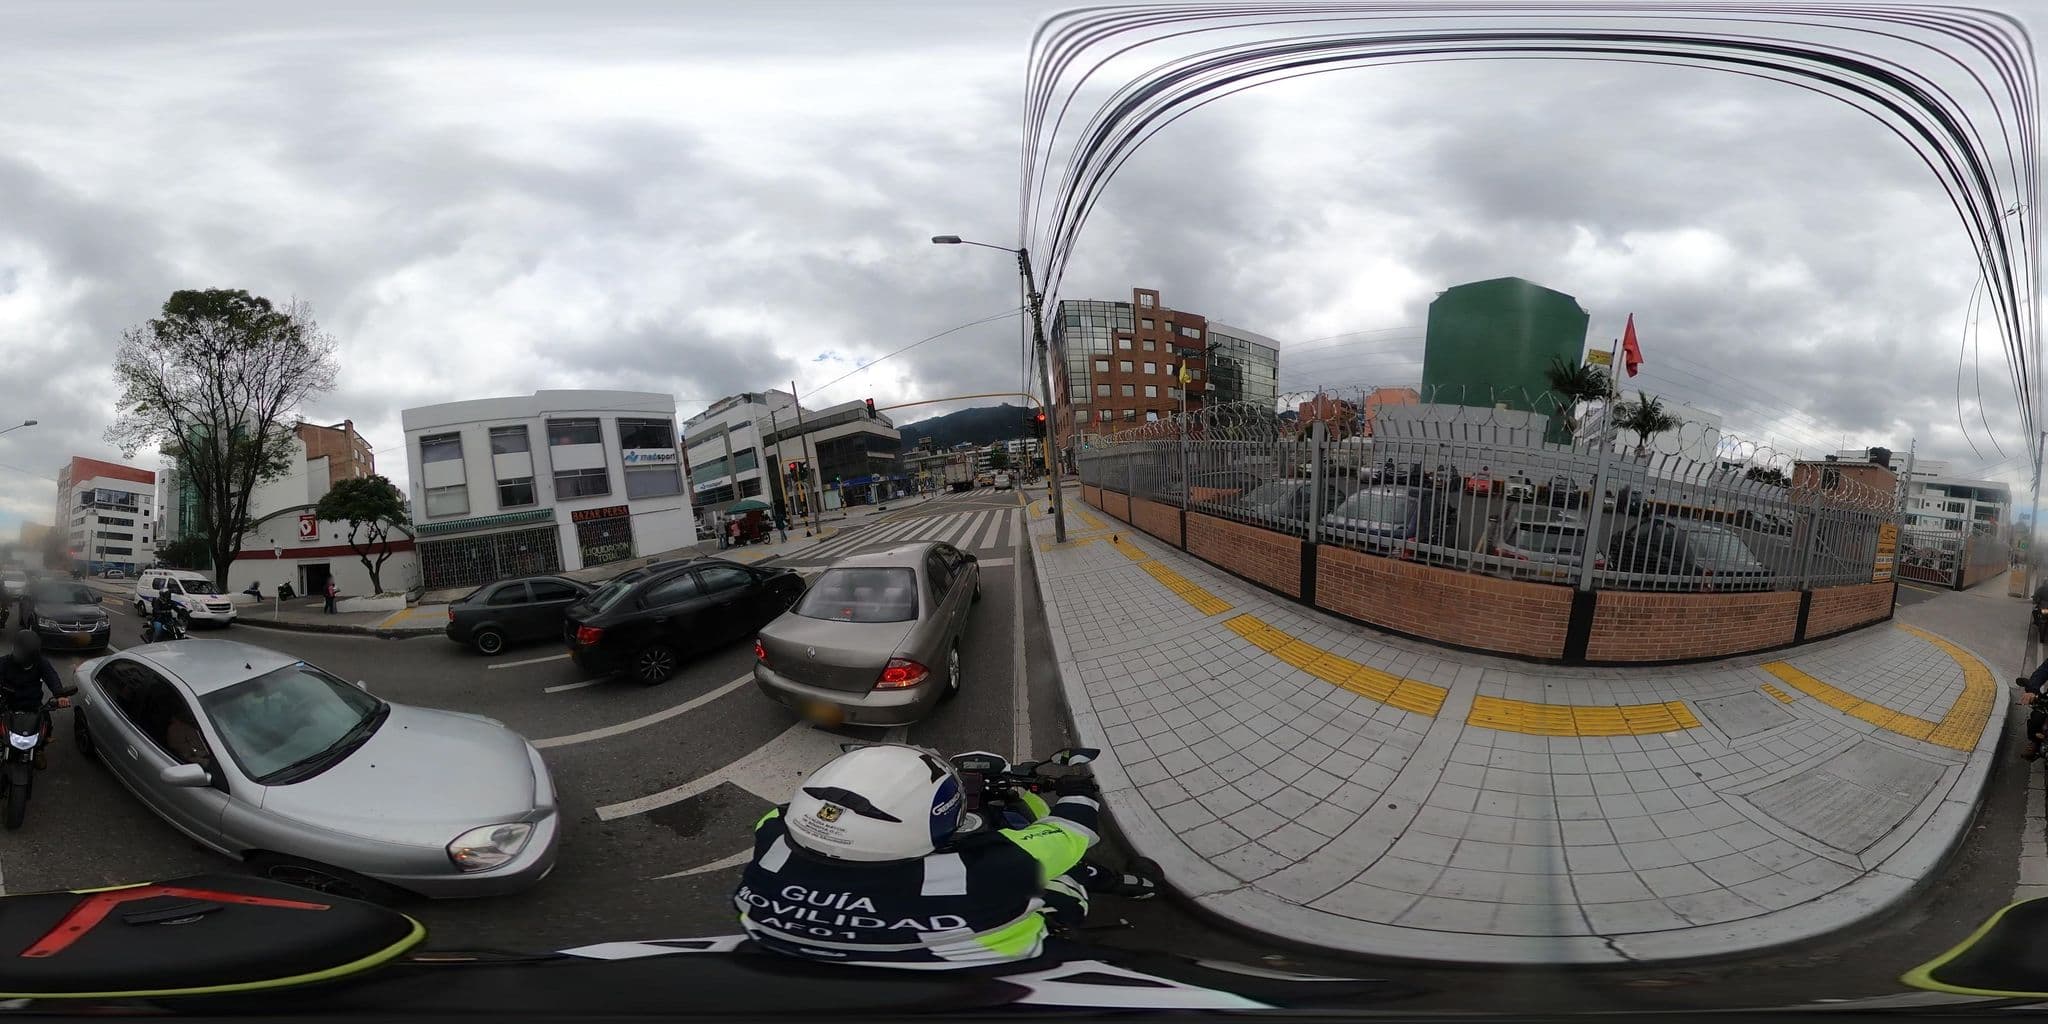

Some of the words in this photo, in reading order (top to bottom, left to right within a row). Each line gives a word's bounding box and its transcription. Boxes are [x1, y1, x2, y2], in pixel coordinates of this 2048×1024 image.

[572, 508, 601, 521] BAZAR
[602, 505, 628, 518] PERSA
[738, 885, 968, 931] MOVILIDAD
[781, 885, 877, 913] GUÍA
